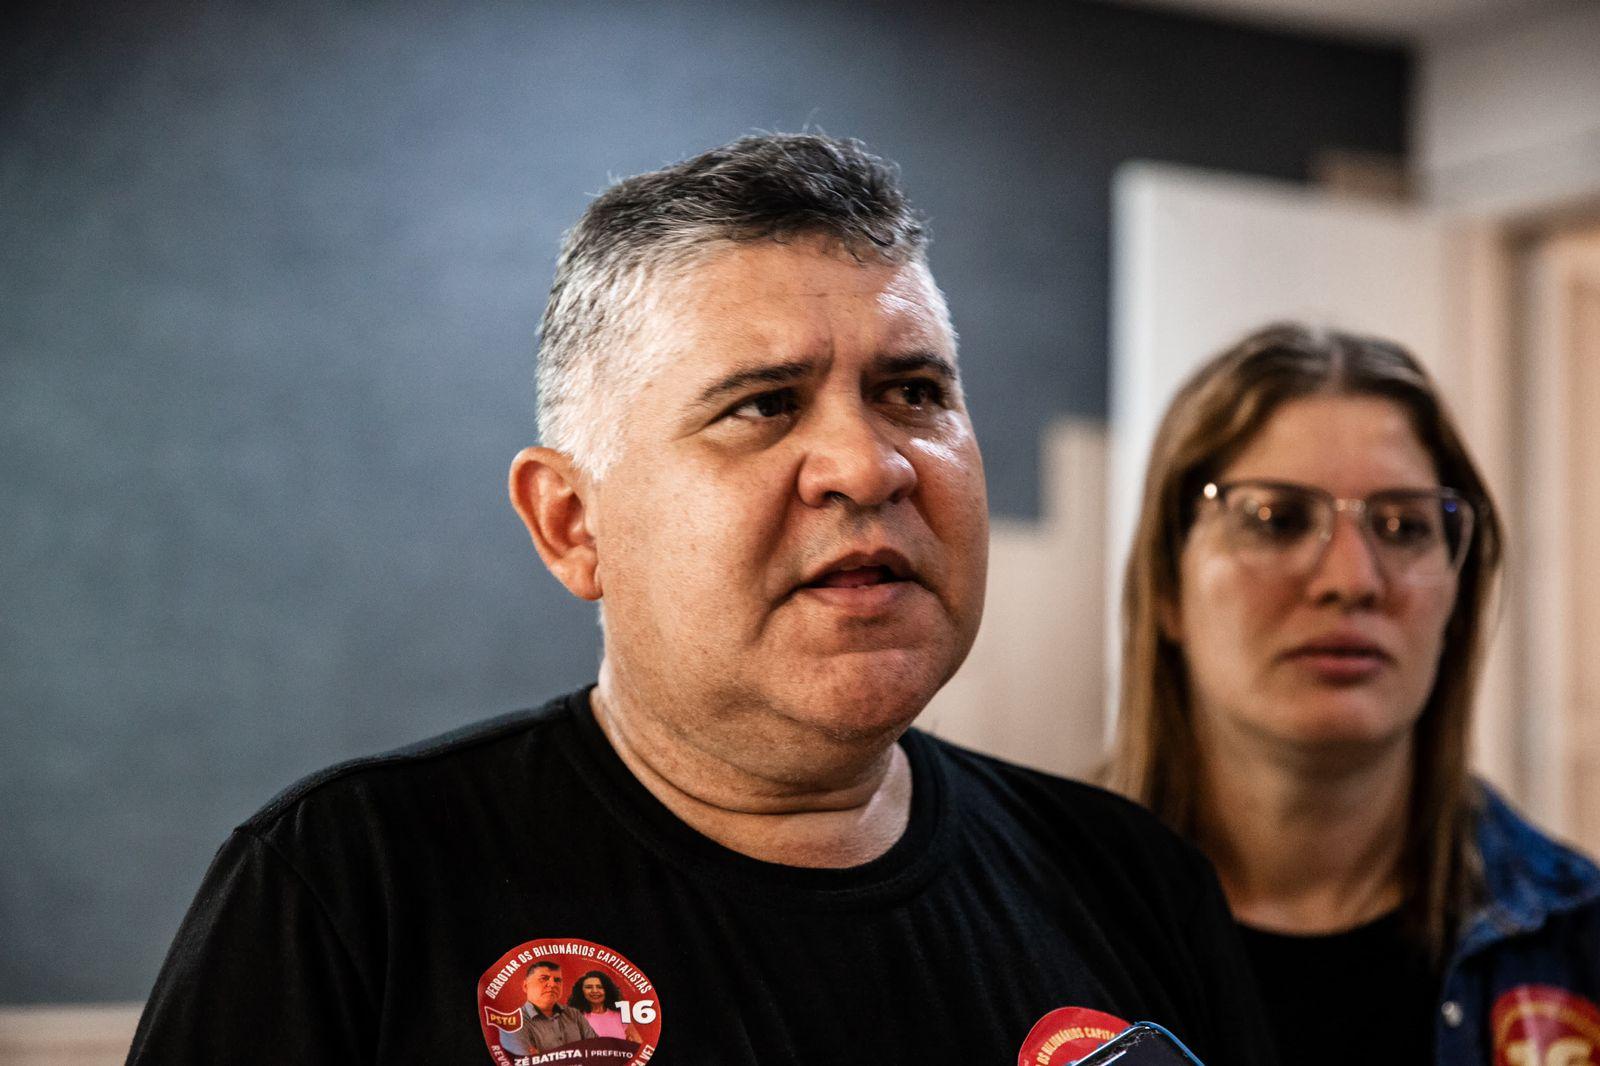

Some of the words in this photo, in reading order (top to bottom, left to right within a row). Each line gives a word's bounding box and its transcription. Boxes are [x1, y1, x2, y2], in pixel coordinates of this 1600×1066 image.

[485, 959, 521, 999] DERROTAR
[517, 950, 533, 964] OS
[532, 943, 596, 958] BILIONÁRIOS
[596, 950, 653, 994] CAPITALISTAS
[490, 1014, 517, 1026] PSTU
[614, 999, 657, 1024] 16
[514, 1056, 530, 1066] ZÉ
[531, 1049, 582, 1065] BATISTA
[590, 1049, 634, 1059] PREFEITO
